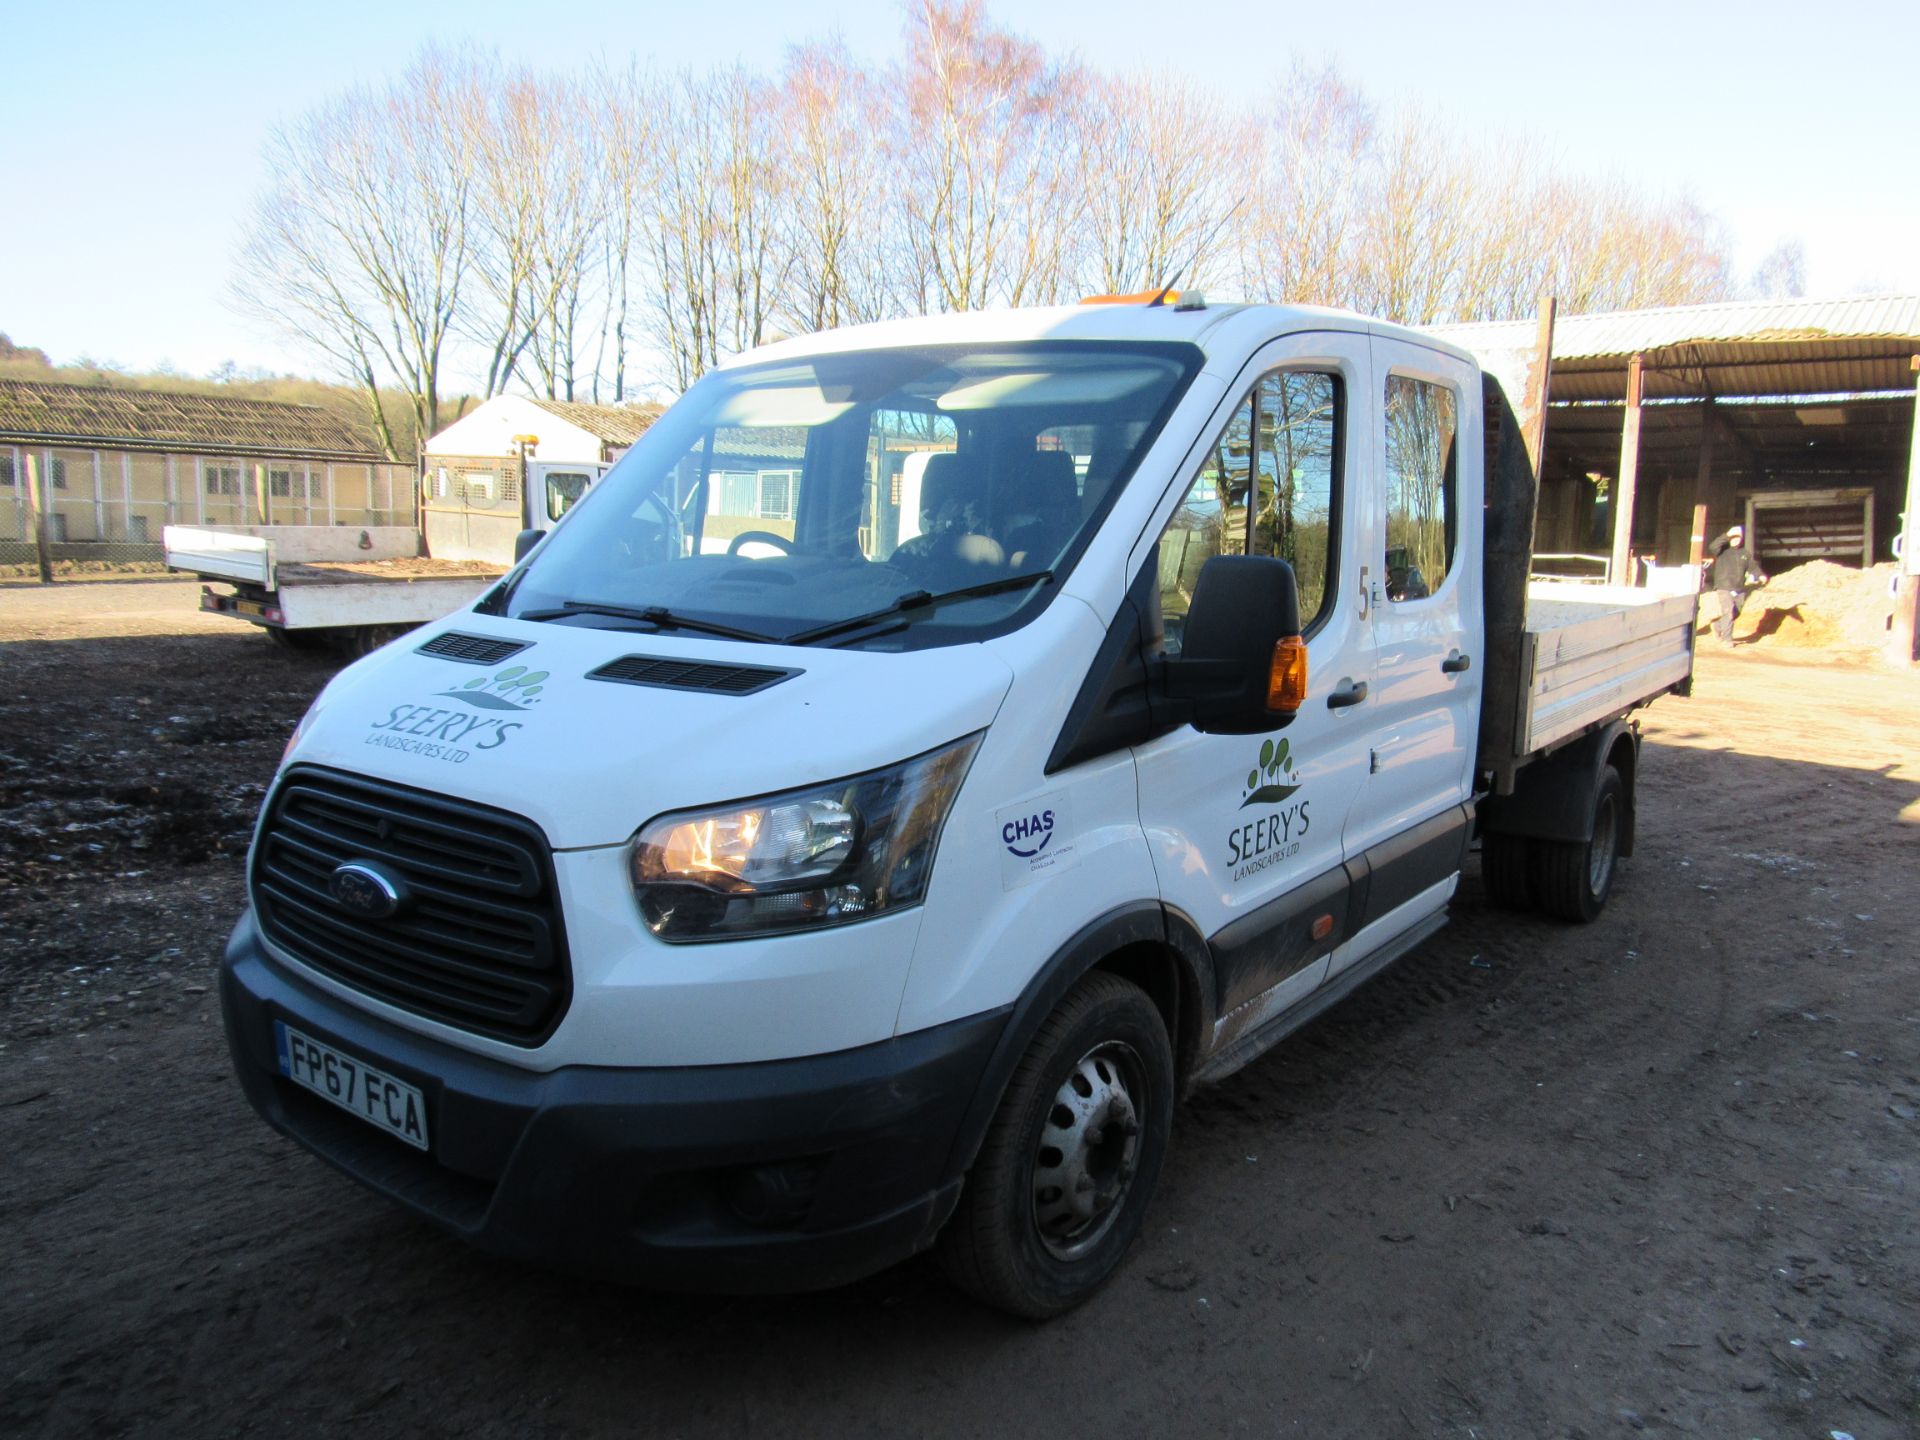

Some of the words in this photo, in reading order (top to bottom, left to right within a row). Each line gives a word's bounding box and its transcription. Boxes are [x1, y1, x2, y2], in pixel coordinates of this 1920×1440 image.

[1359, 566, 1368, 622] 5
[364, 733, 442, 758] LANDSCAPES
[441, 747, 470, 764] LTD
[371, 704, 523, 750] SEERY'S
[1002, 809, 1054, 844] CHAS
[1226, 800, 1310, 867] SEERY'S
[1233, 852, 1285, 882] LANDSCAPES
[1285, 842, 1300, 858] LTD
[290, 1034, 356, 1104] FP67
[364, 1070, 423, 1142] FCA
